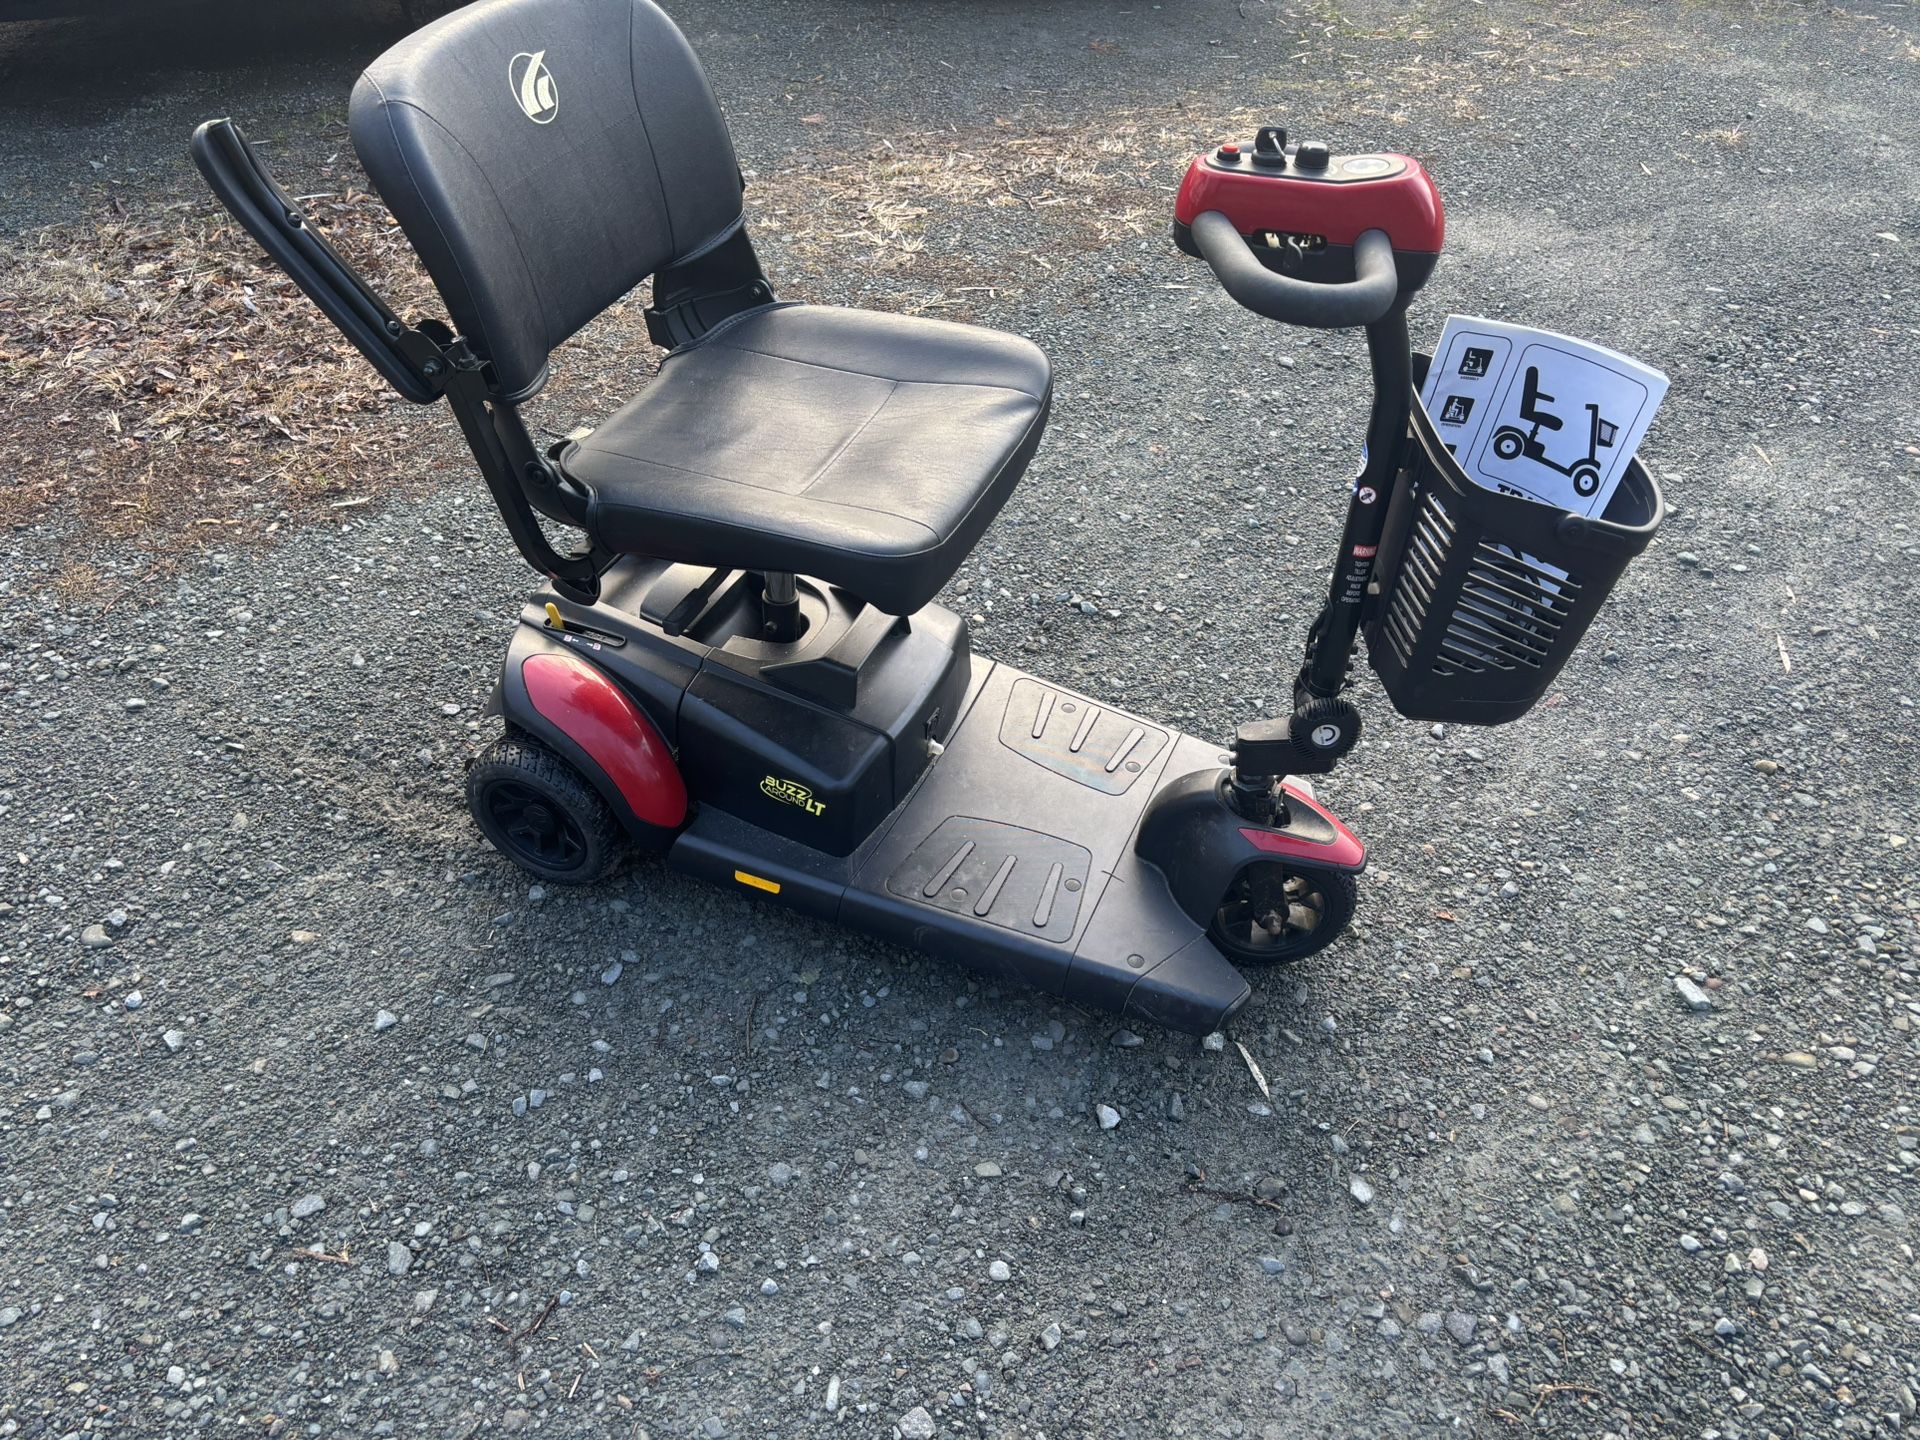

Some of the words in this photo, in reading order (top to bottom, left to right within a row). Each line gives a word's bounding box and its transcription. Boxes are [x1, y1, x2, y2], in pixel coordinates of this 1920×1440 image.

[765, 776, 807, 800] BUZZ
[765, 785, 806, 807] AROUND
[805, 799, 826, 816] LT
